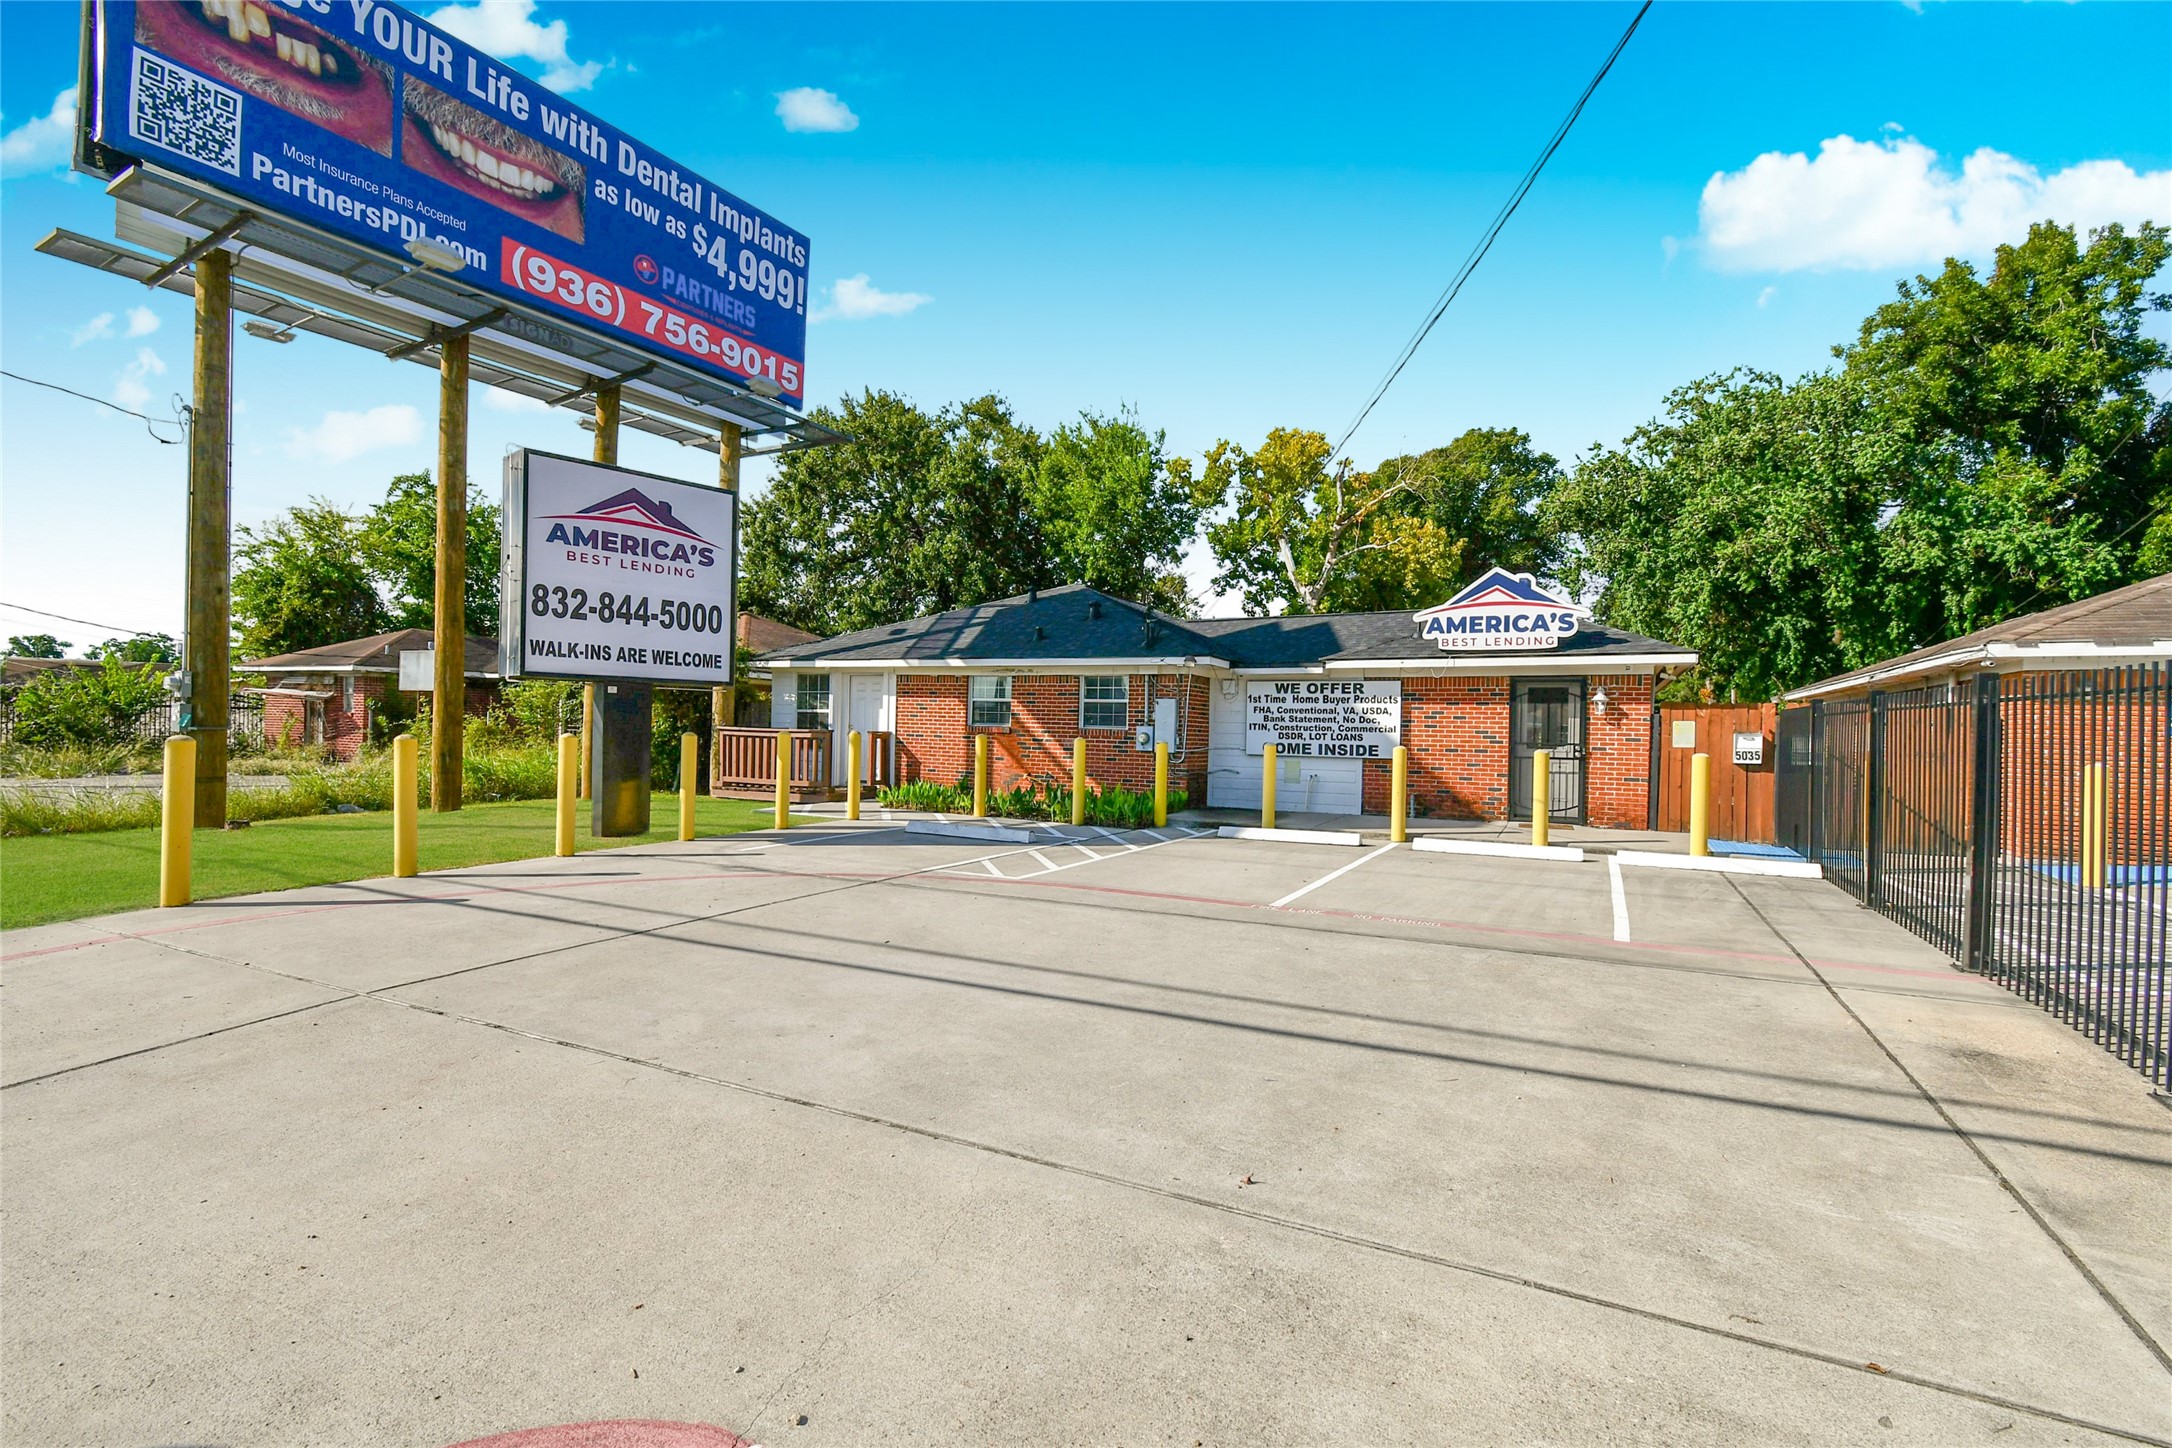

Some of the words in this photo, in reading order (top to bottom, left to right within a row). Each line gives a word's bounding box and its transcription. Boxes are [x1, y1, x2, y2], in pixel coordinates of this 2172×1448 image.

[350, 0, 453, 83] YOUR
[467, 56, 529, 121] Life
[540, 103, 608, 164] with
[618, 140, 701, 213] Dental
[709, 188, 805, 268] Implants
[283, 142, 316, 169] Most
[319, 153, 379, 195] Insurance
[382, 185, 414, 209] Plans
[416, 201, 466, 231] Accepted
[594, 178, 618, 206] as
[625, 188, 659, 226] low
[665, 213, 686, 239] as
[692, 223, 805, 315] $4,999!
[662, 266, 756, 328] PARTNERS
[511, 246, 626, 326] (936)
[640, 300, 799, 391] 756-9015
[546, 522, 715, 567] AMERICA'S
[566, 550, 612, 567] BEST
[620, 559, 696, 579] LENDING
[531, 584, 723, 634] 832-844-5000
[1426, 612, 1575, 635] AMERICA'S
[1441, 637, 1478, 647] BEST
[1485, 636, 1555, 647] LENDING
[530, 639, 612, 662] WALK-INS
[616, 647, 647, 664] ARE
[652, 650, 722, 669] WELCOME
[1248, 694, 1262, 704] 1st
[1264, 695, 1287, 704] Time
[1292, 695, 1320, 704] Home
[1322, 695, 1351, 706] Buyer
[1353, 695, 1399, 704] Products
[1275, 683, 1301, 694] WE
[1306, 683, 1365, 695] OFFER
[1253, 706, 1275, 715] FHA,
[1277, 706, 1340, 716] Conventional,
[1342, 707, 1359, 716] VA,
[1361, 707, 1392, 716] USDA,
[1263, 715, 1286, 723] Bank
[1288, 715, 1340, 725] Statement,
[1343, 716, 1356, 724] No
[1359, 716, 1381, 725] Doc,
[1249, 723, 1270, 732] ITIN,
[1273, 723, 1336, 733] Construction,
[1338, 724, 1397, 733] Commercial
[1278, 732, 1307, 741] DSDR,
[1309, 733, 1328, 741] LOT
[1330, 733, 1364, 741] LOANS
[1263, 742, 1312, 755] OME
[1318, 743, 1379, 757] INSIDE
[1735, 751, 1761, 761] 5035
